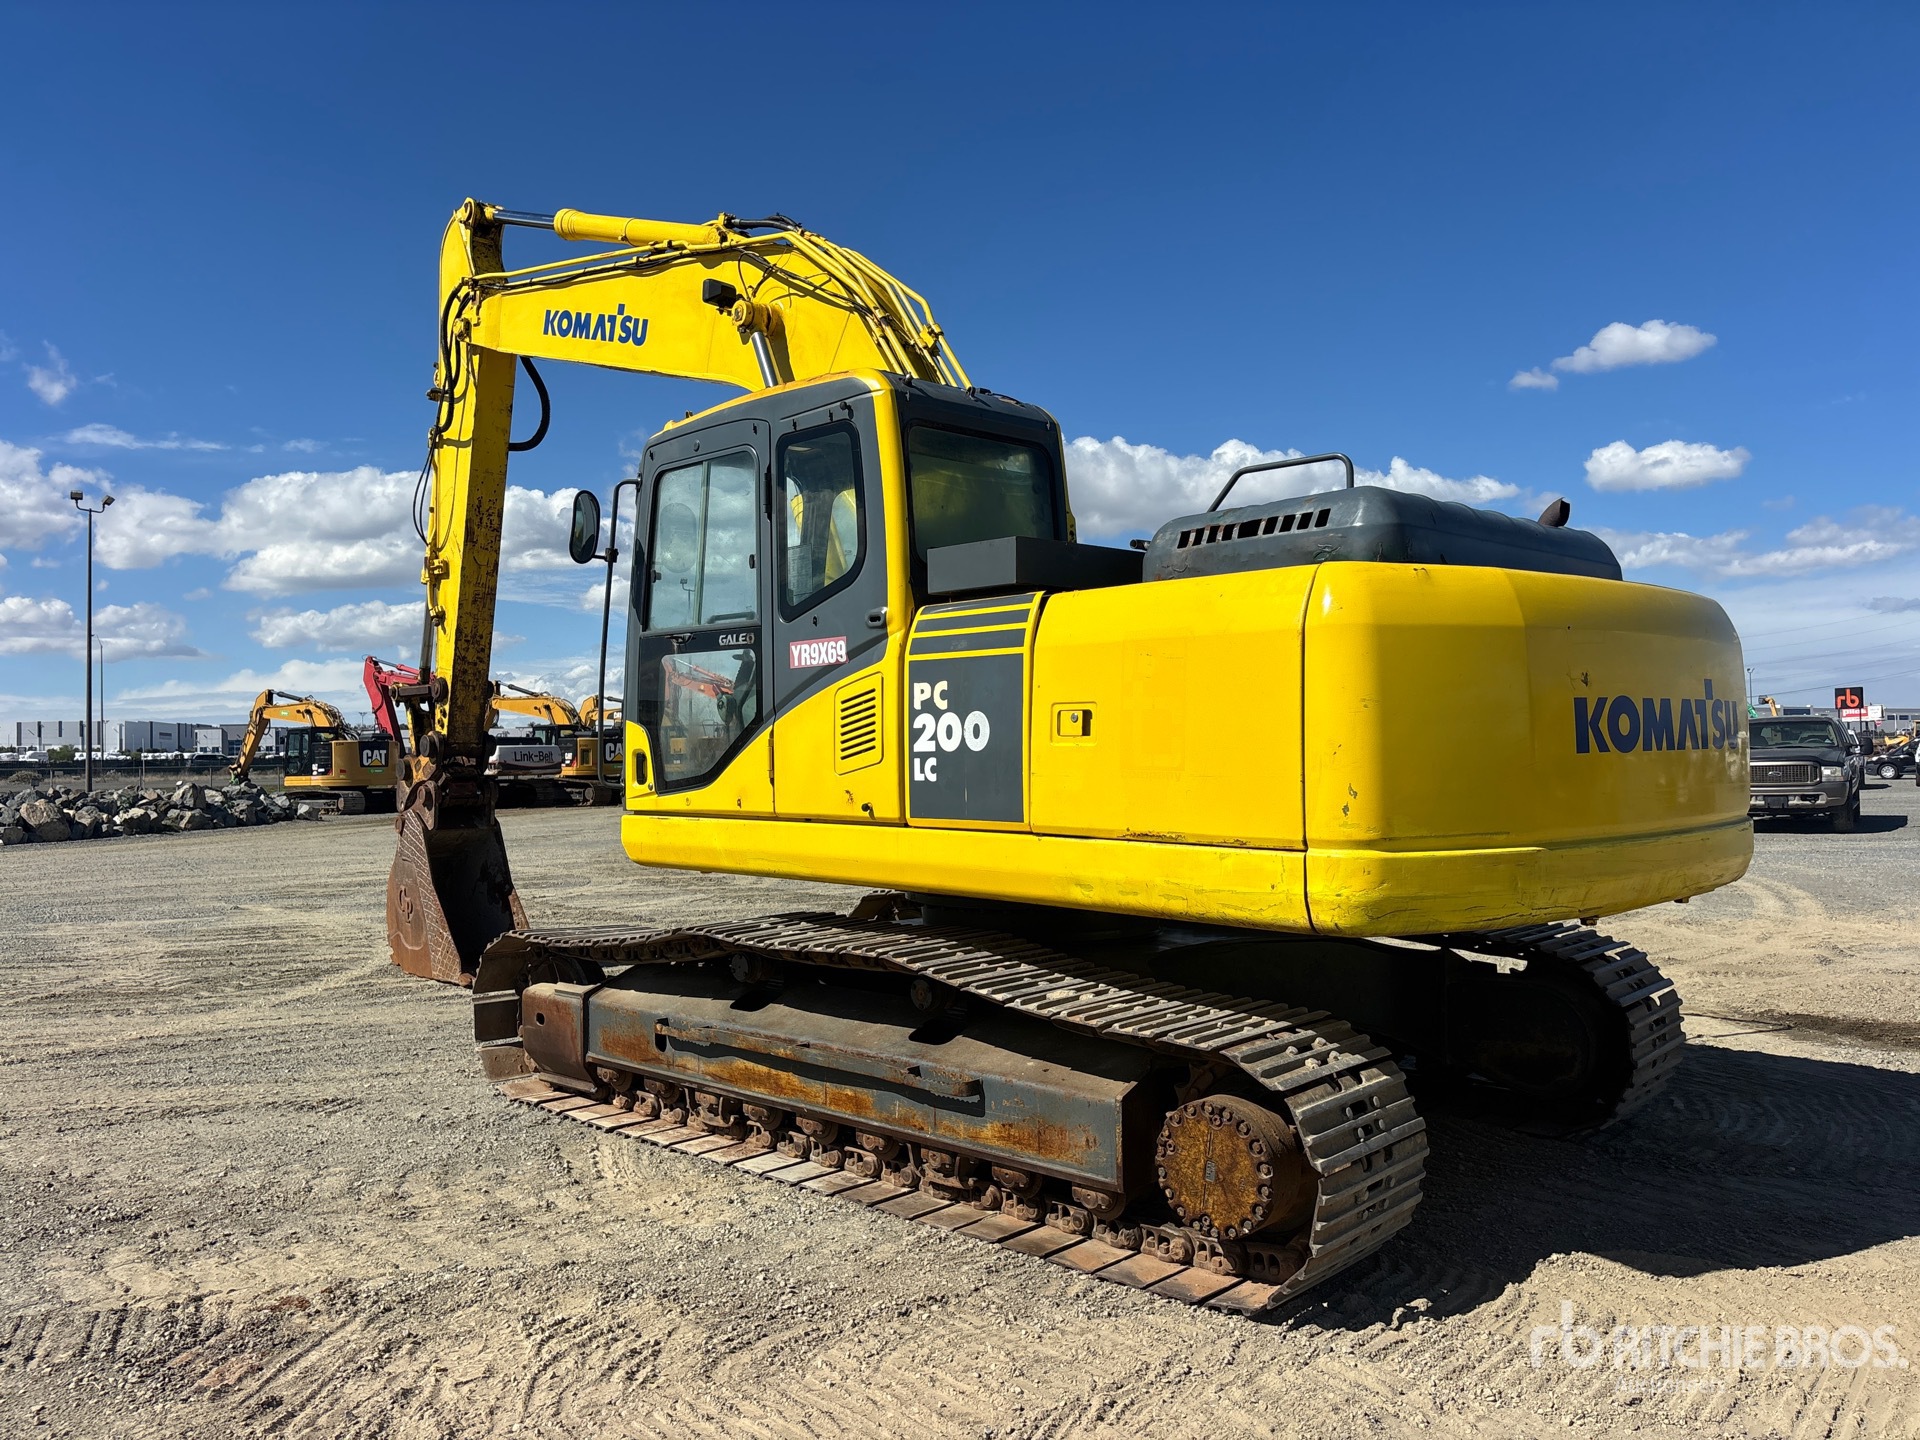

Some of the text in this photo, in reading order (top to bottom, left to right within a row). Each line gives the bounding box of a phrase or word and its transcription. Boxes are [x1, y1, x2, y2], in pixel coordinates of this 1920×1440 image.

[543, 303, 648, 346] KOMATSU
[791, 640, 847, 667] YR9X69
[913, 680, 948, 710] PC
[1837, 689, 1860, 708] rb
[1573, 678, 1738, 754] KOMATSU
[913, 710, 990, 752] 200
[362, 749, 387, 766] CAT
[513, 751, 554, 762] Link-Belt
[605, 742, 624, 762] CA
[913, 757, 937, 782] LC
